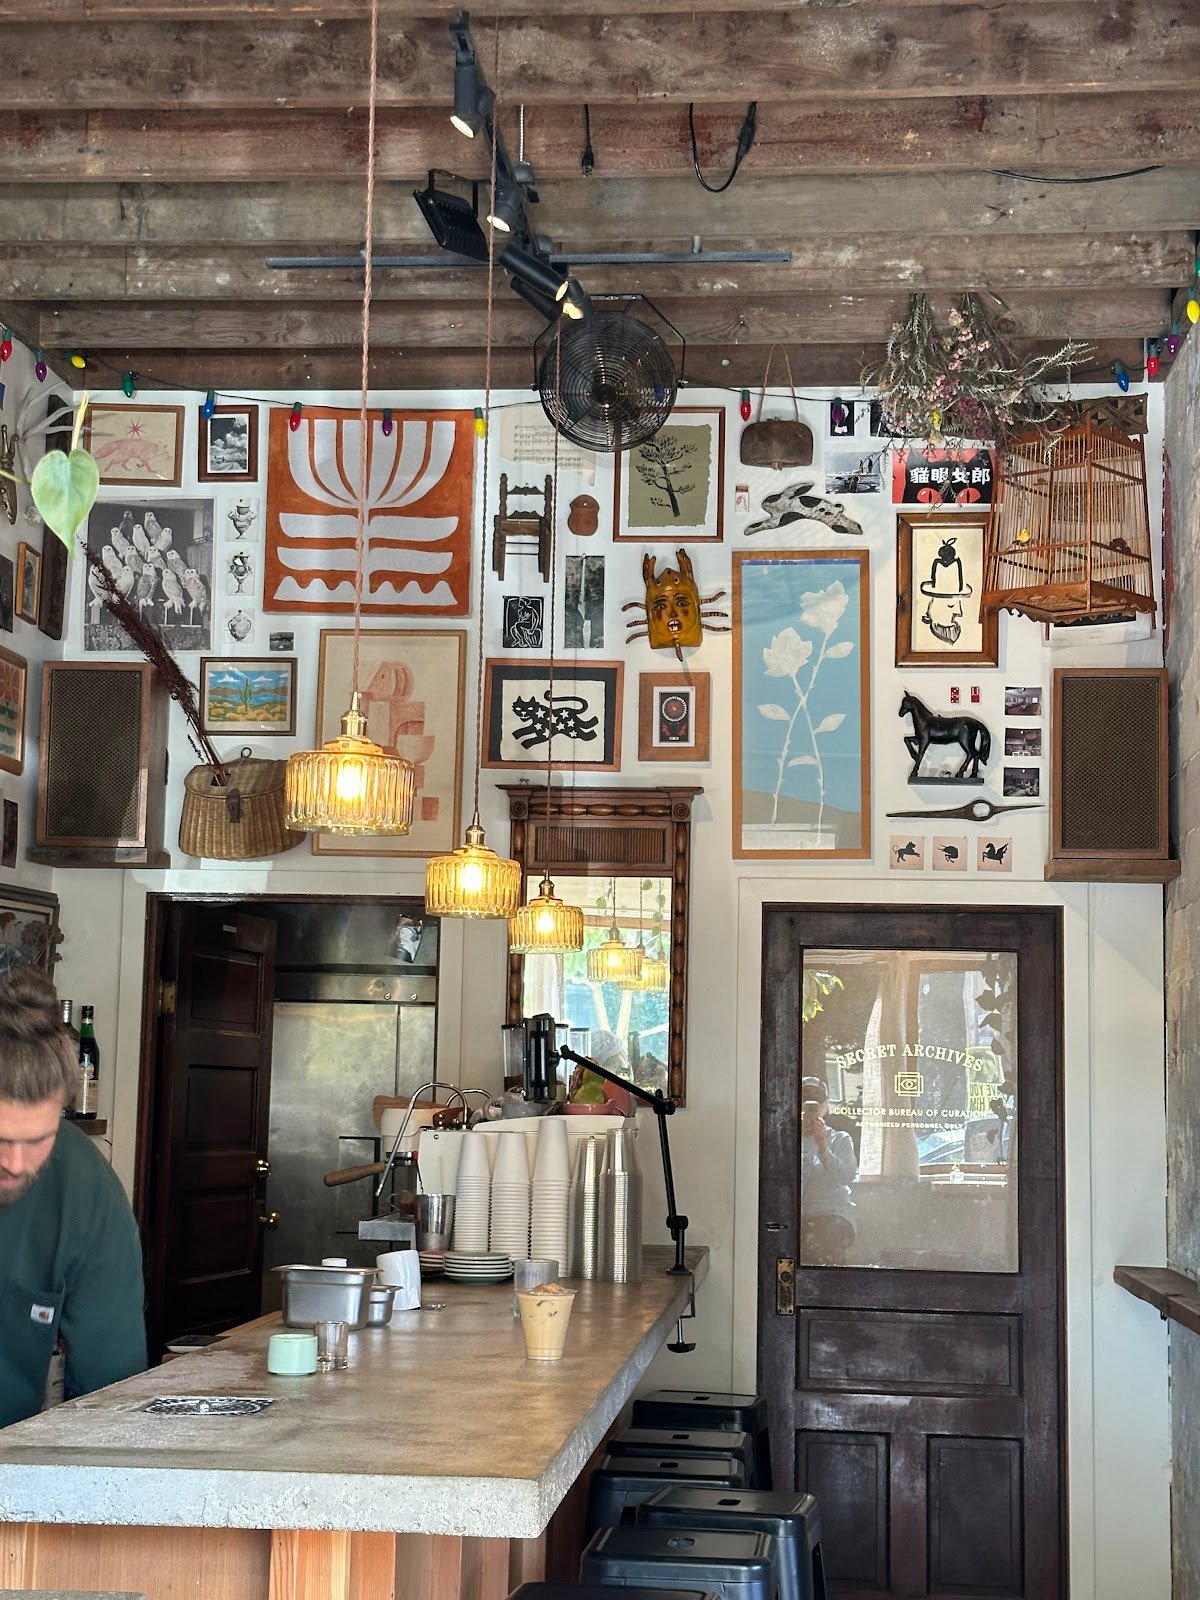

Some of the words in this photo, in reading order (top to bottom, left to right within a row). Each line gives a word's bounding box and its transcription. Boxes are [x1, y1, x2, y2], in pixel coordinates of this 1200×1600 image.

[910, 467, 991, 485] 貓眼女郎
[835, 1044, 896, 1069] SECRET
[902, 1044, 984, 1072] ARCHIVES
[833, 1107, 886, 1116] COLLECTOR
[889, 1108, 924, 1117] BUREAU
[926, 1109, 939, 1117] OF
[941, 1110, 987, 1118] CURATION
